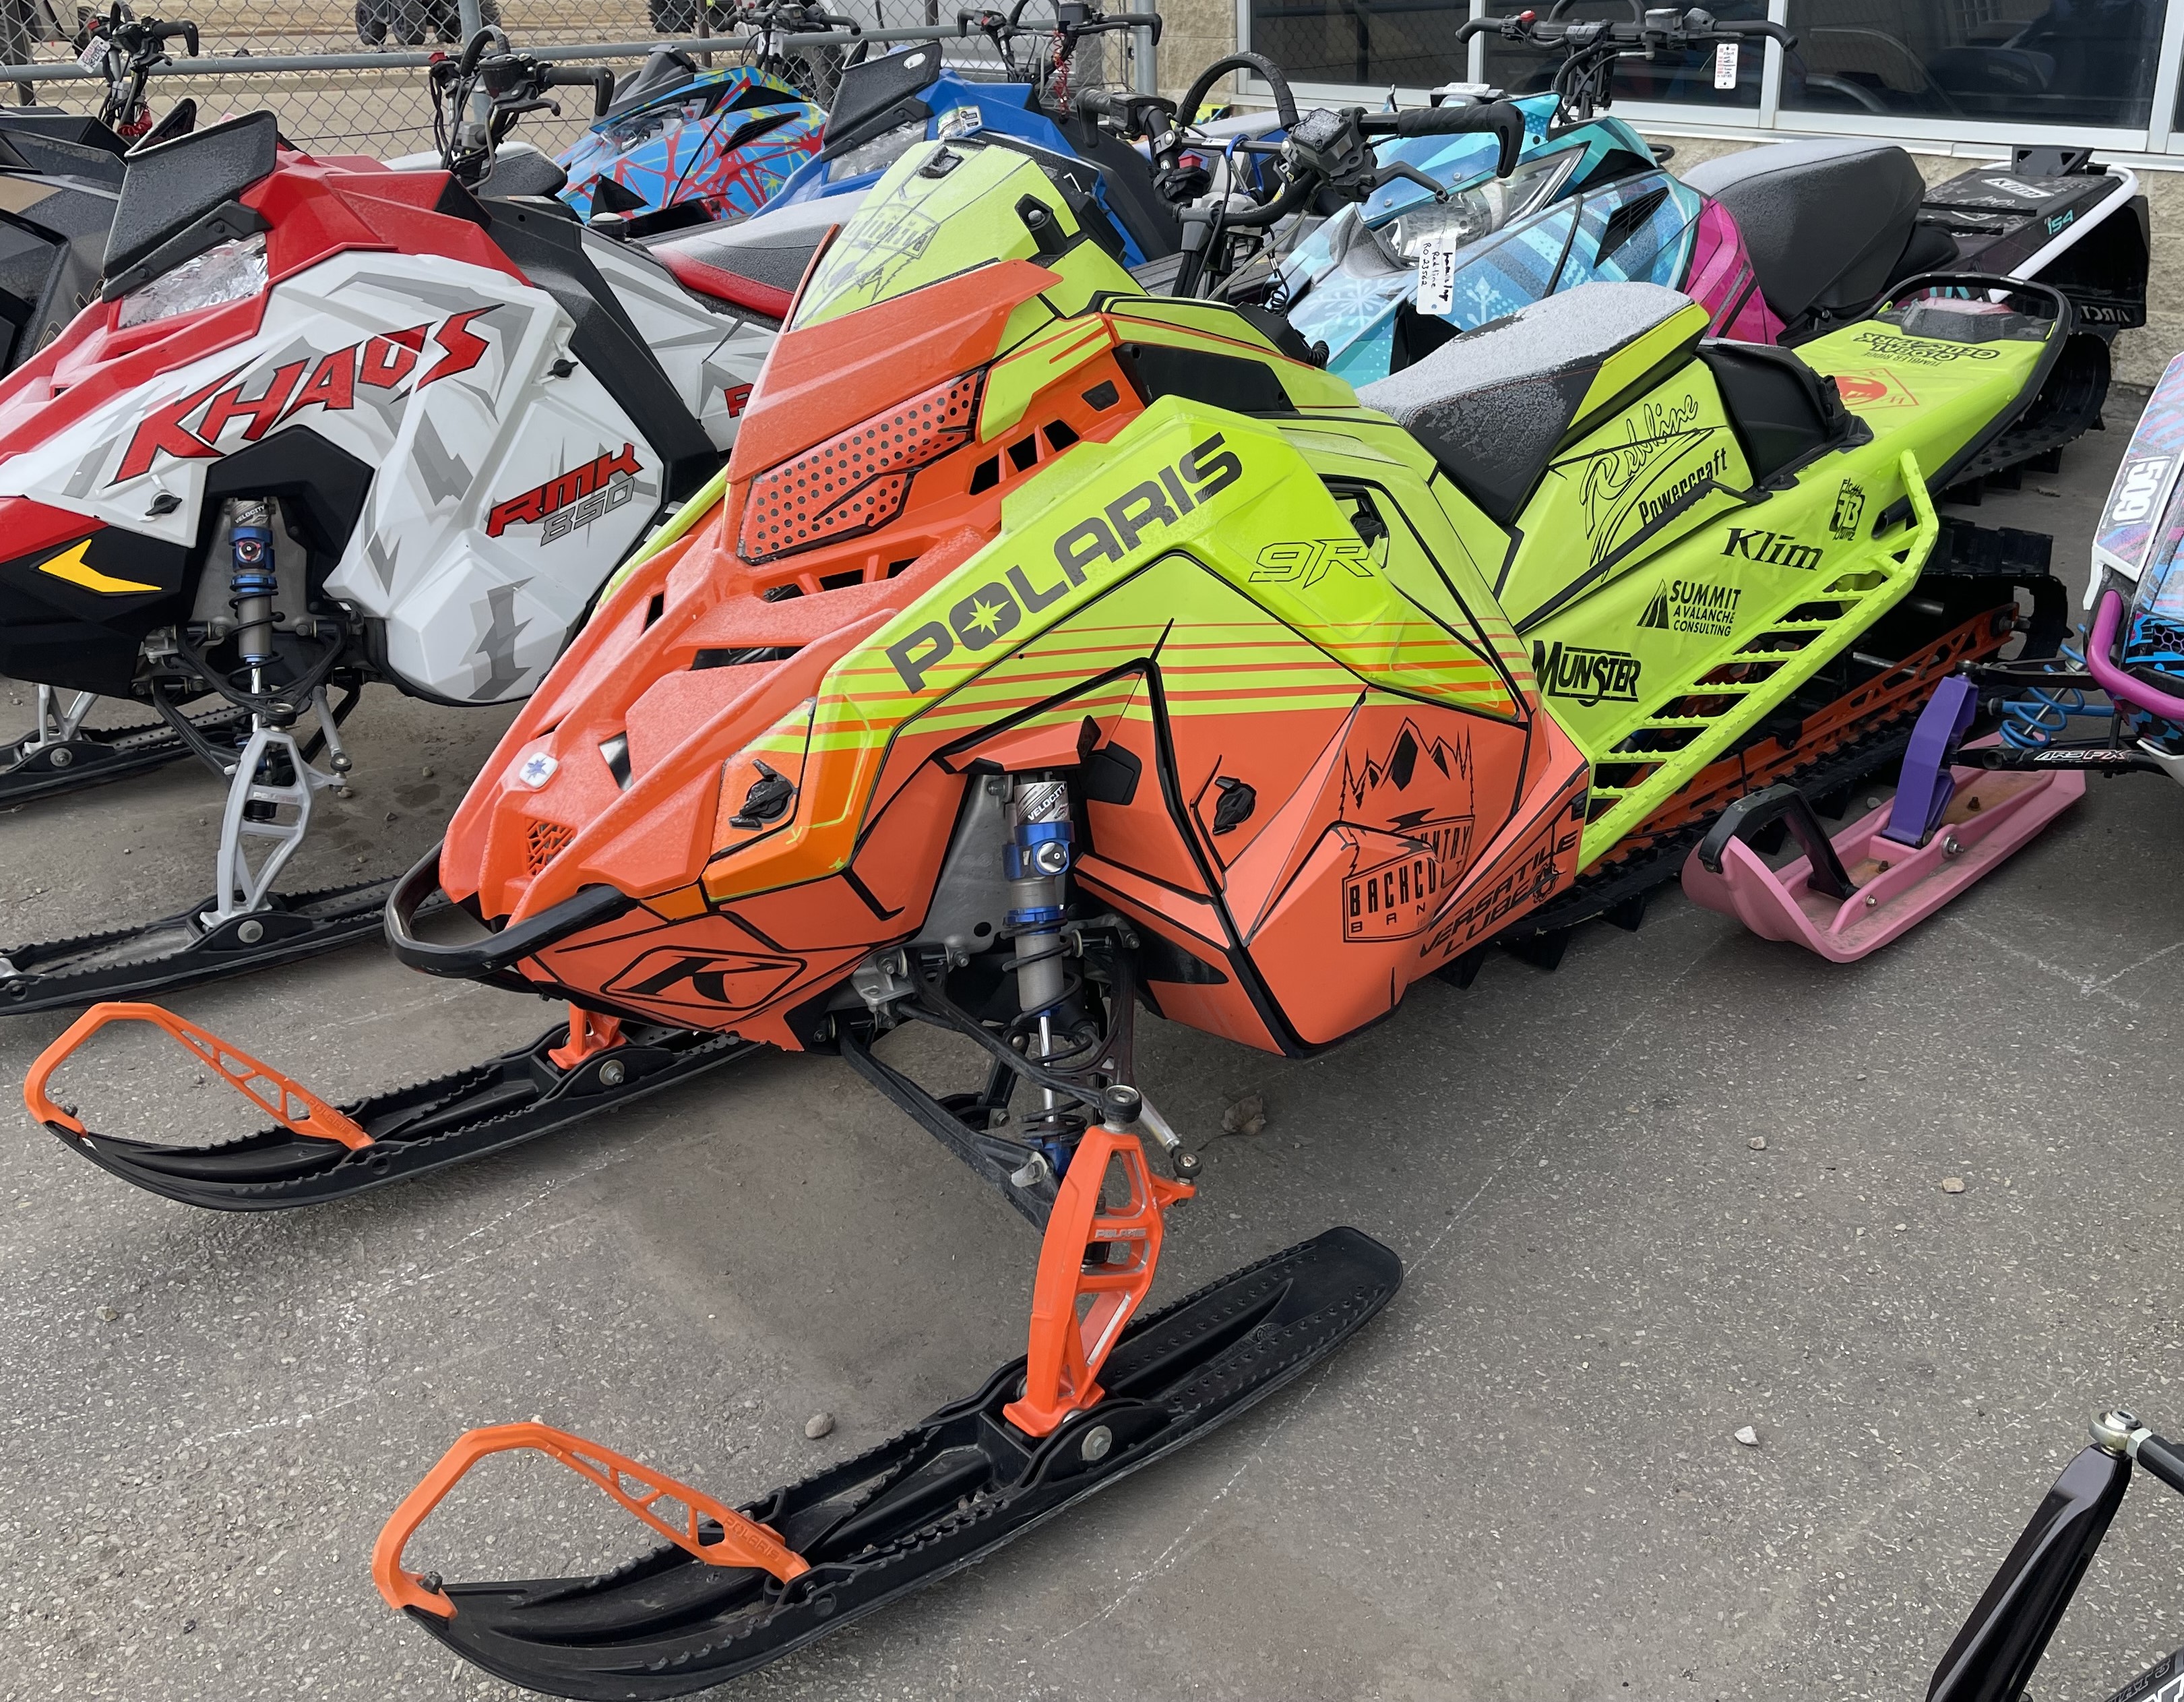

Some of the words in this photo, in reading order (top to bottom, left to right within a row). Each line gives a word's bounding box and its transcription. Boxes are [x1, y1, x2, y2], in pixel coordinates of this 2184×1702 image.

[2045, 209, 2074, 235] 154
[102, 303, 506, 489] KHAOS
[235, 504, 265, 524] VELOCITY
[485, 442, 645, 539] RMK
[540, 477, 635, 547] 850
[1637, 447, 1728, 529] Powercraft
[885, 431, 1243, 695] POLARIS
[1247, 538, 1375, 590] 9R
[1668, 580, 1742, 611] SUMMIT
[1673, 605, 1737, 624] AVALANCHE
[1673, 619, 1732, 638] CONSULTING
[1027, 782, 1066, 821] VELOCITY
[1420, 828, 1579, 959] VERSATILE
[1442, 878, 1531, 959] LUBE
[724, 1515, 782, 1562] POLARIS
